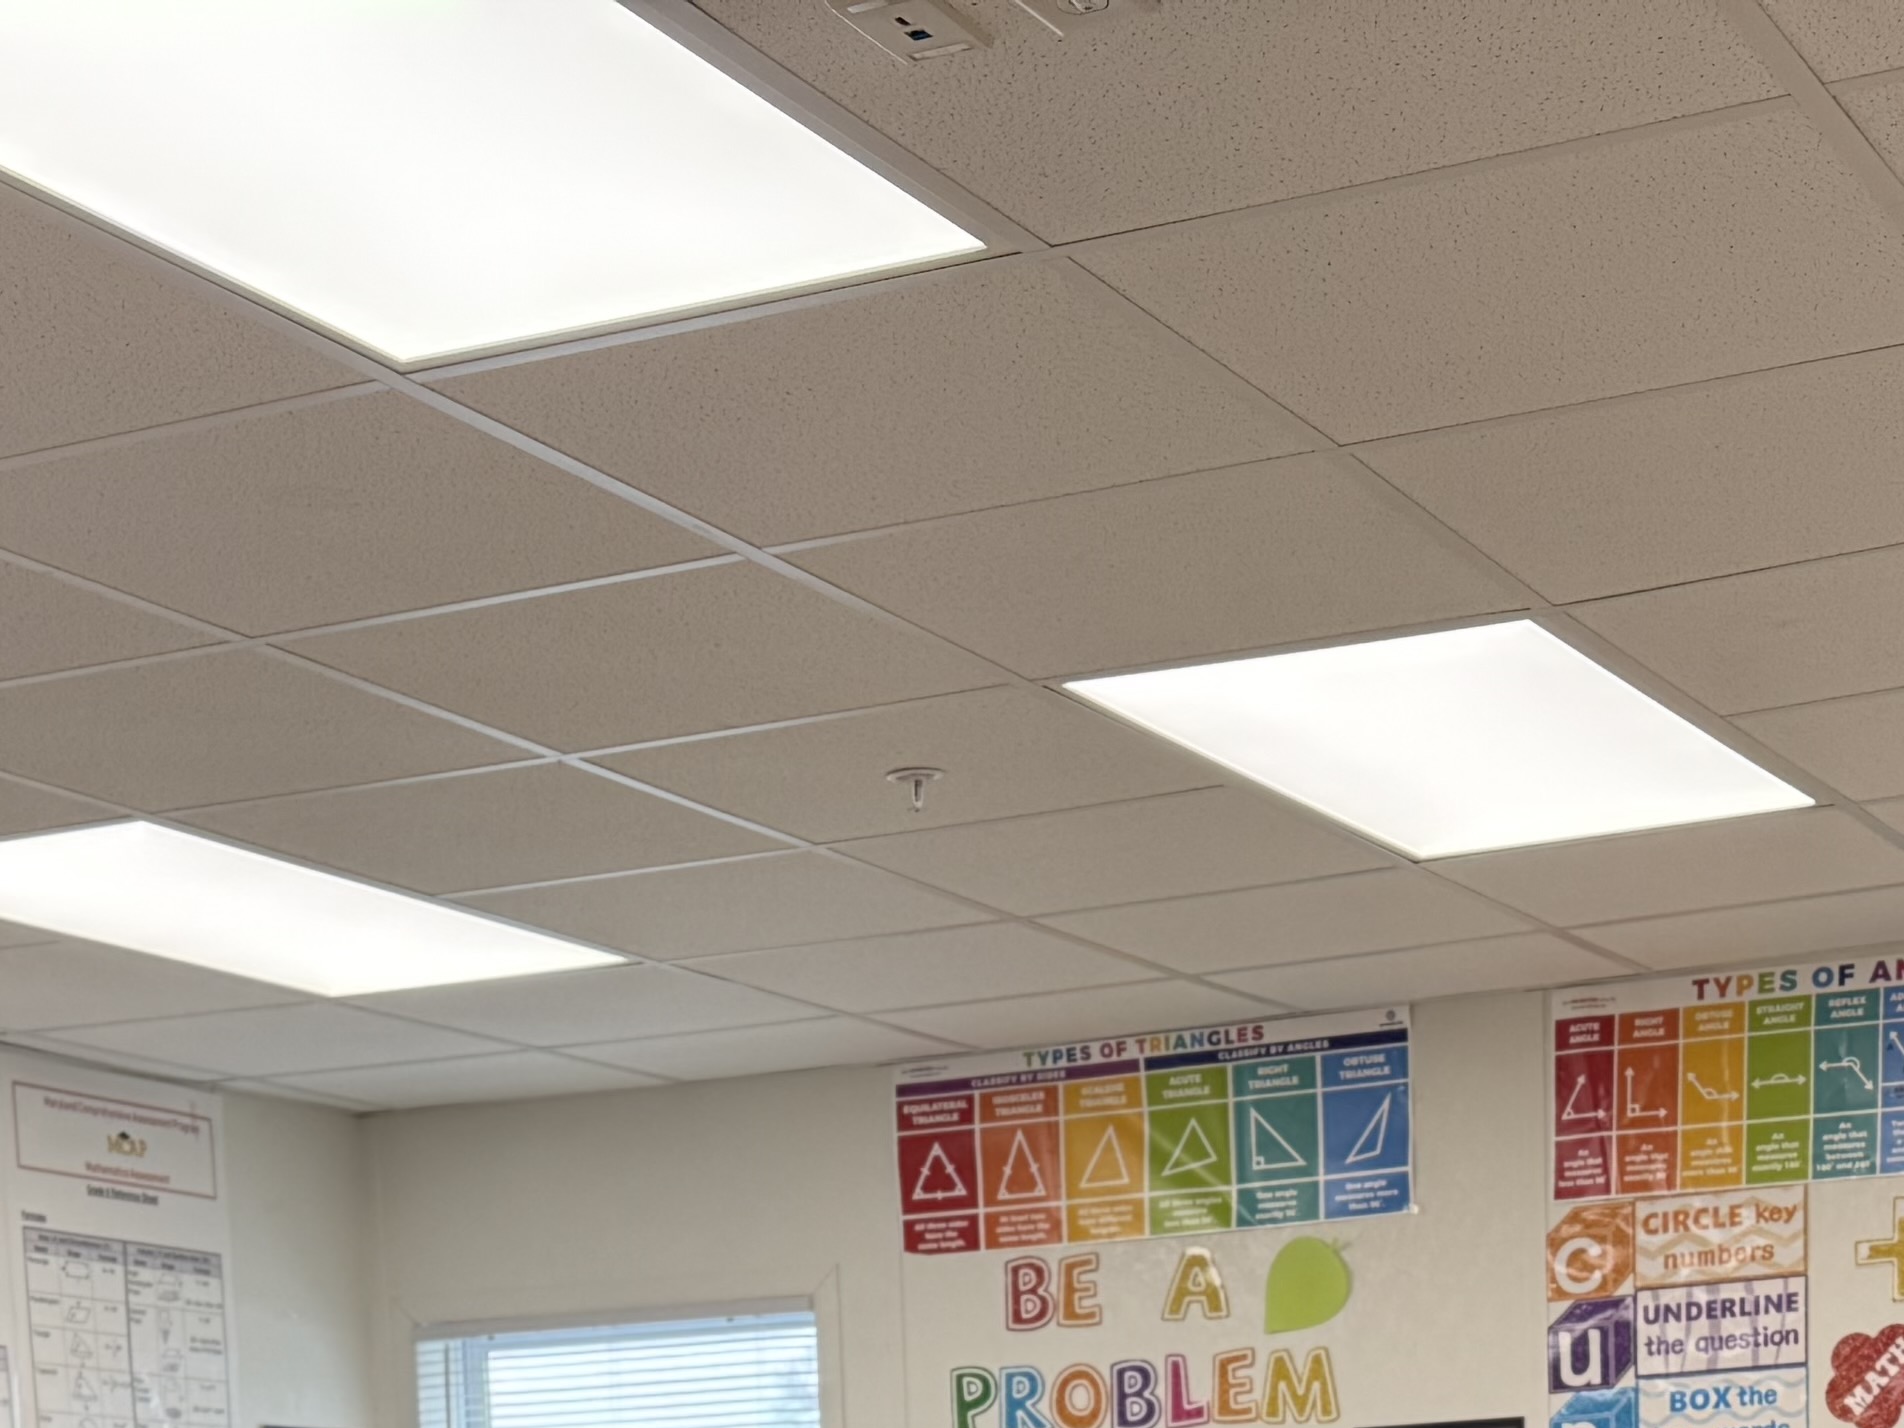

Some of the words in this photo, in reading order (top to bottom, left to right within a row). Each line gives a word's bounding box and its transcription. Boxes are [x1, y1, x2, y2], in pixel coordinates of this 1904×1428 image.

[1692, 969, 1798, 1001] TYPES
[1812, 964, 1855, 989] OF
[1023, 1045, 1092, 1067] TYPES
[1099, 1040, 1127, 1058] OF
[1135, 1023, 1265, 1056] TRIANGLES
[1641, 1204, 1744, 1237] CIRCLE
[1755, 1203, 1798, 1226] key
[1553, 1237, 1603, 1294] C
[1663, 1243, 1775, 1271] numbers
[1005, 1252, 1102, 1332] BE
[1161, 1246, 1229, 1321] A
[1642, 1291, 1799, 1325] UNDERLINE
[1557, 1327, 1601, 1387] U
[1645, 1334, 1685, 1357] the
[1695, 1325, 1799, 1357] question
[1669, 1385, 1732, 1413] BOX
[1737, 1382, 1778, 1406] the
